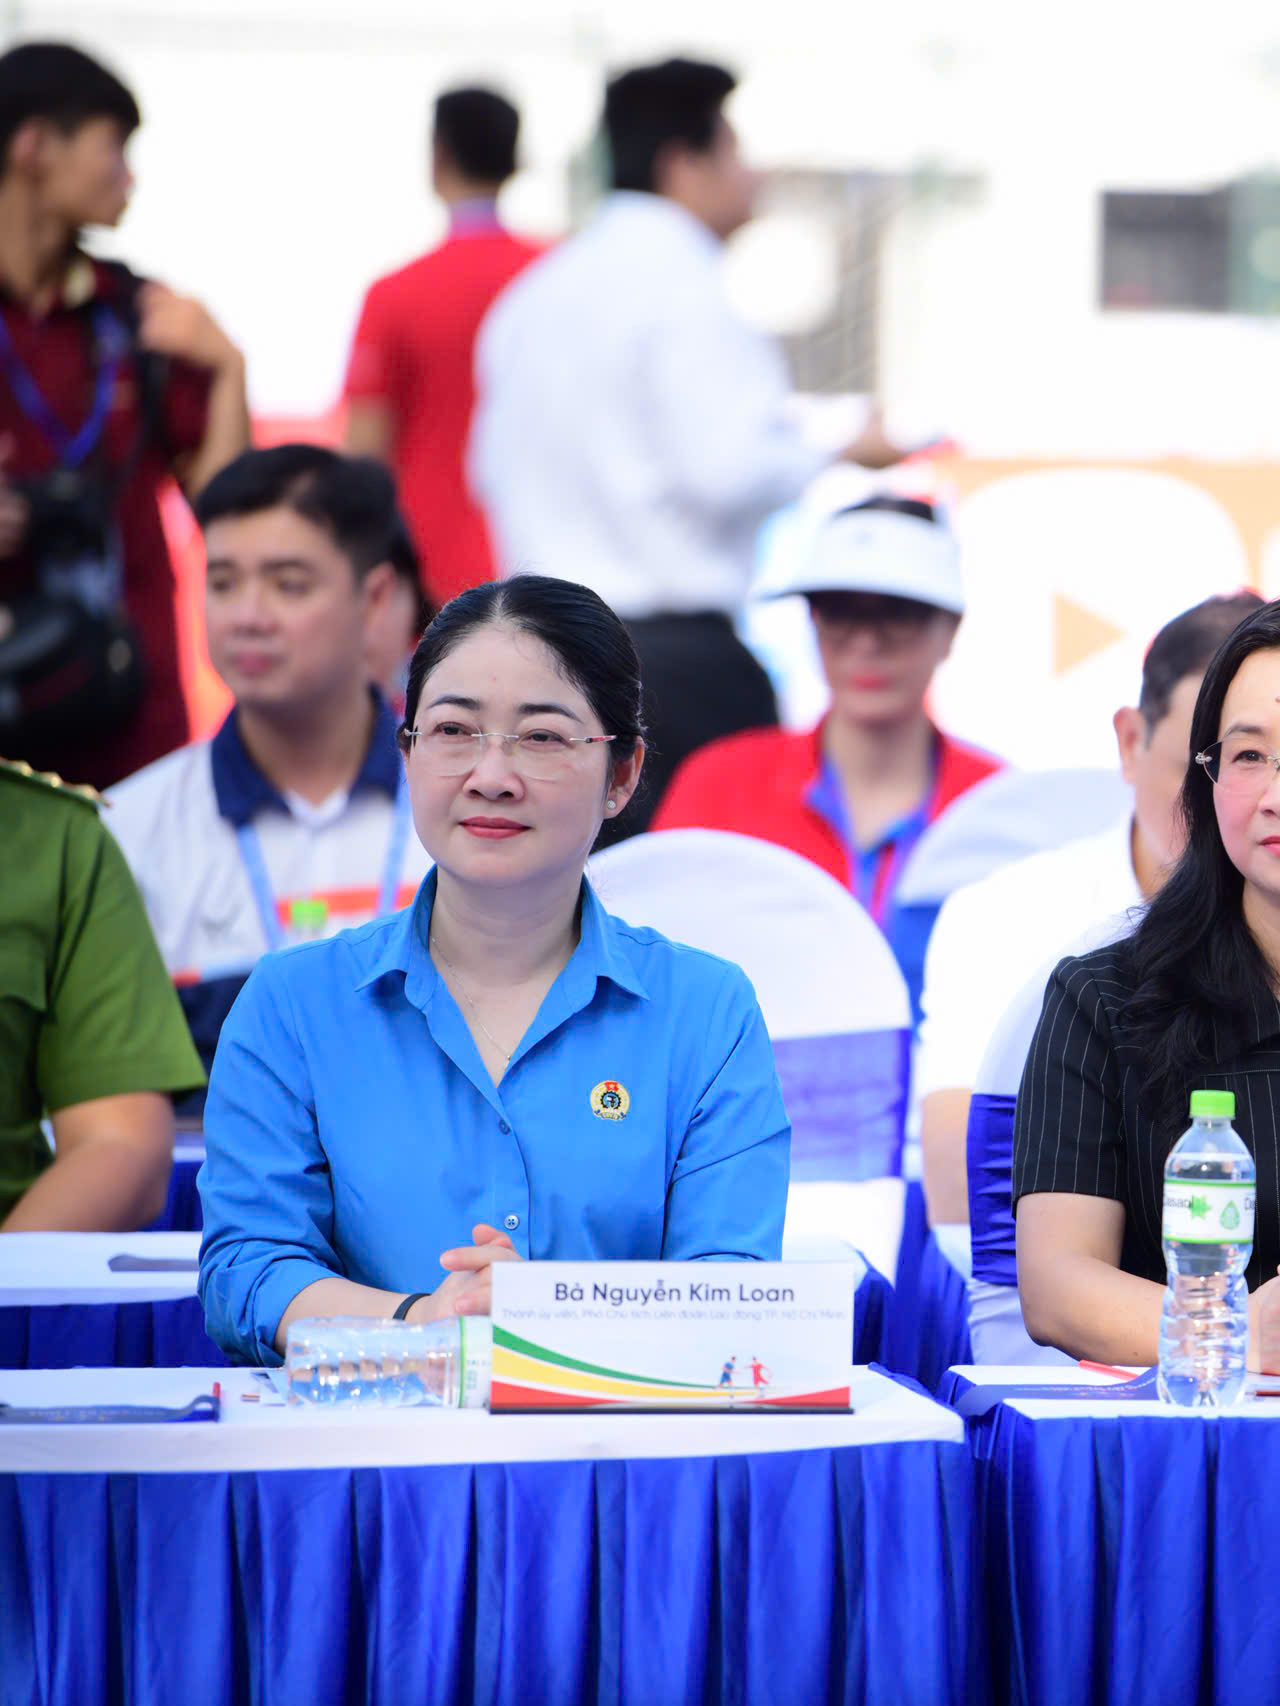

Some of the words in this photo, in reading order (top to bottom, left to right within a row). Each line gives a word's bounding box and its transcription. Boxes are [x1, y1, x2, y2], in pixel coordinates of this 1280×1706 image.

[555, 1283, 584, 1301] Bà
[593, 1279, 682, 1306] Nguyễn
[690, 1283, 731, 1302] Kim
[739, 1283, 795, 1302] Loan
